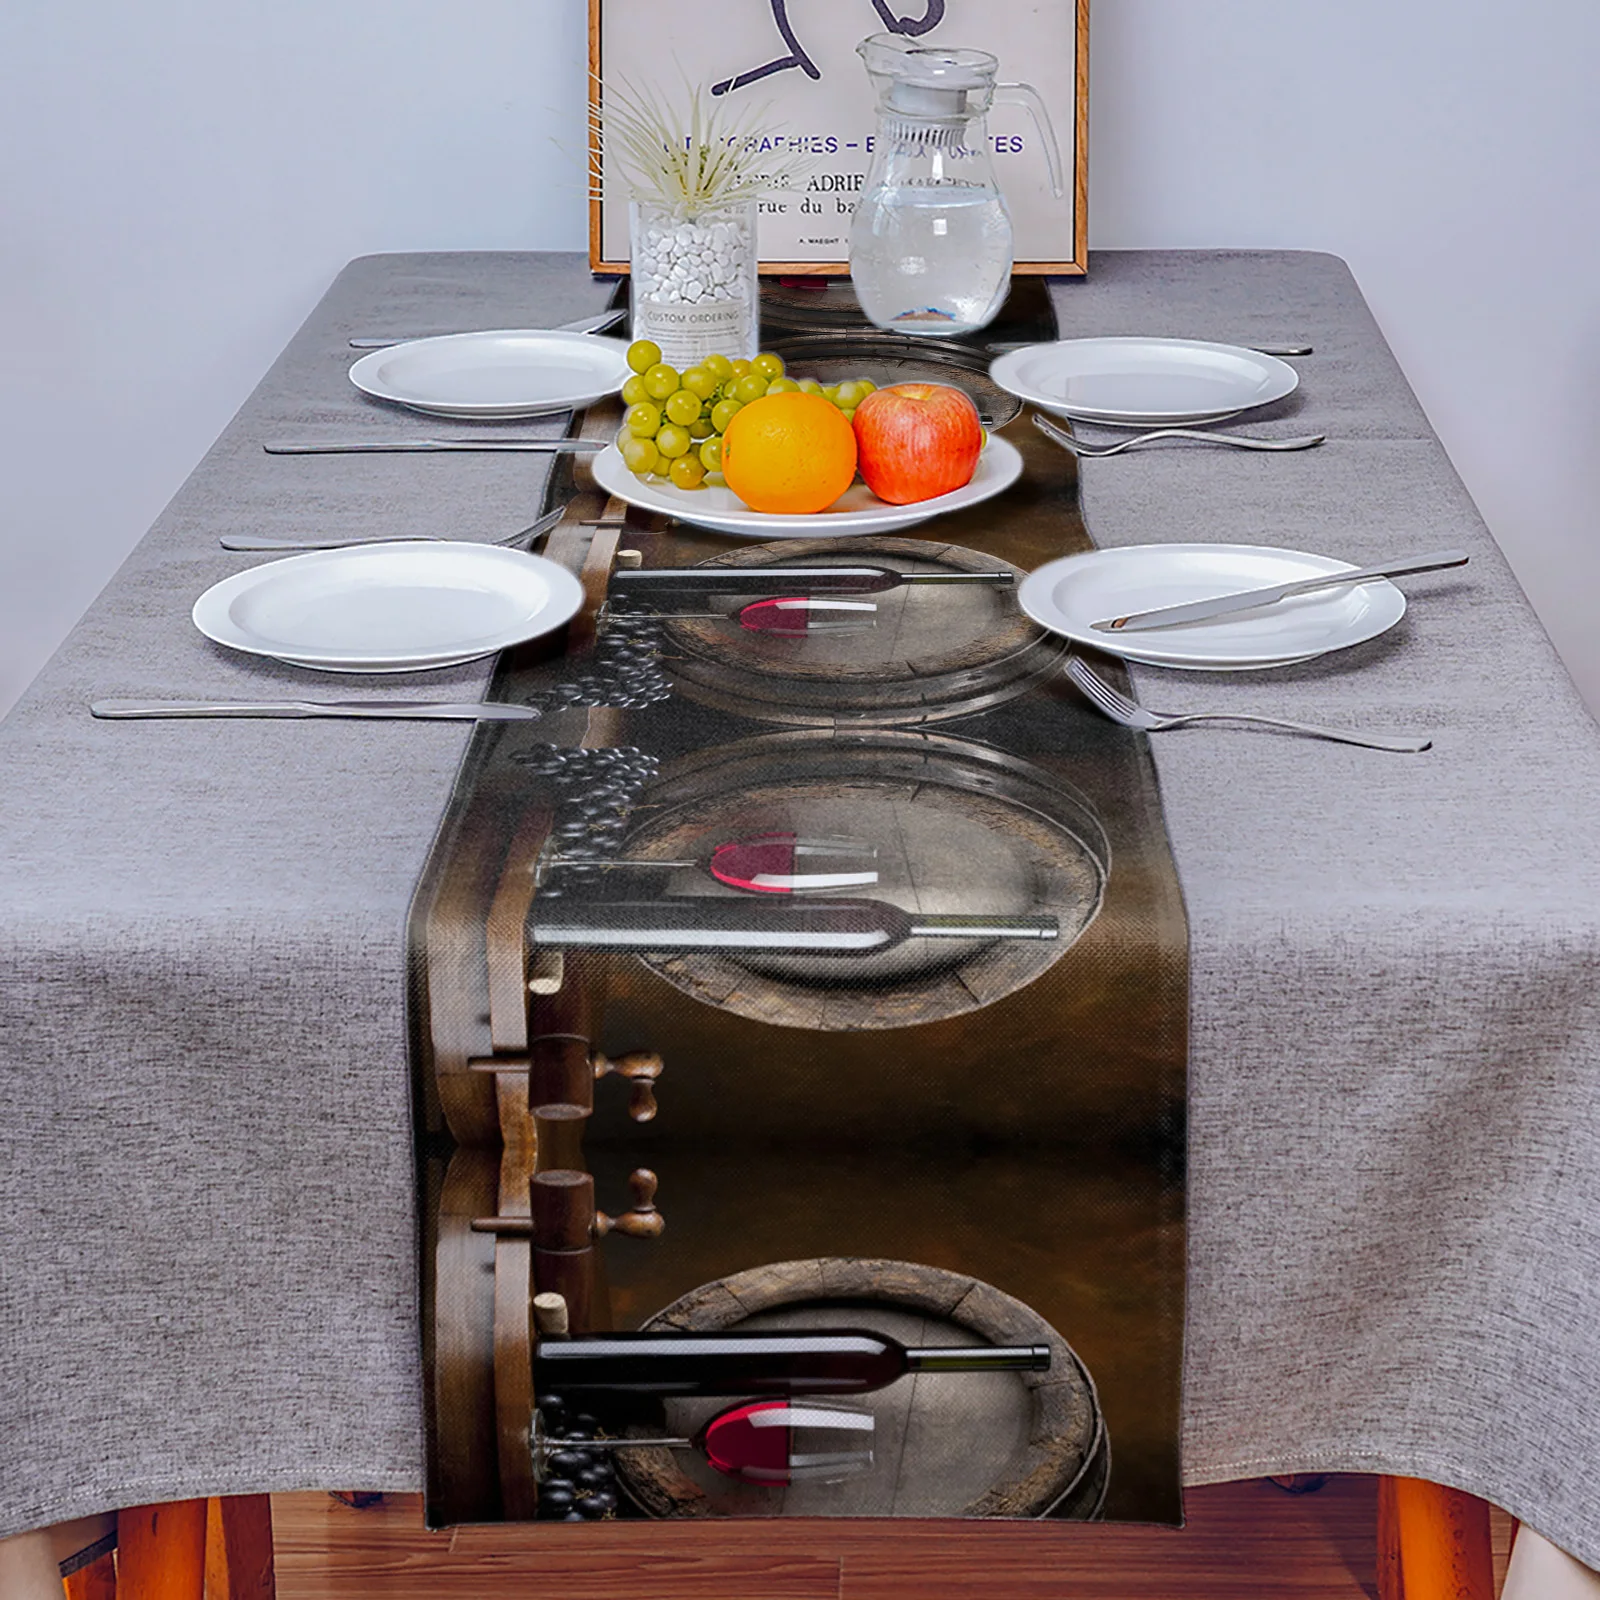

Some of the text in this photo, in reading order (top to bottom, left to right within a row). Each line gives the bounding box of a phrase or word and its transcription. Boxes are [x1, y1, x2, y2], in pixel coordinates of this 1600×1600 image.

[758, 202, 787, 214] rue
[800, 197, 823, 214] du
[648, 310, 740, 323] CUSTOM ORDERING
